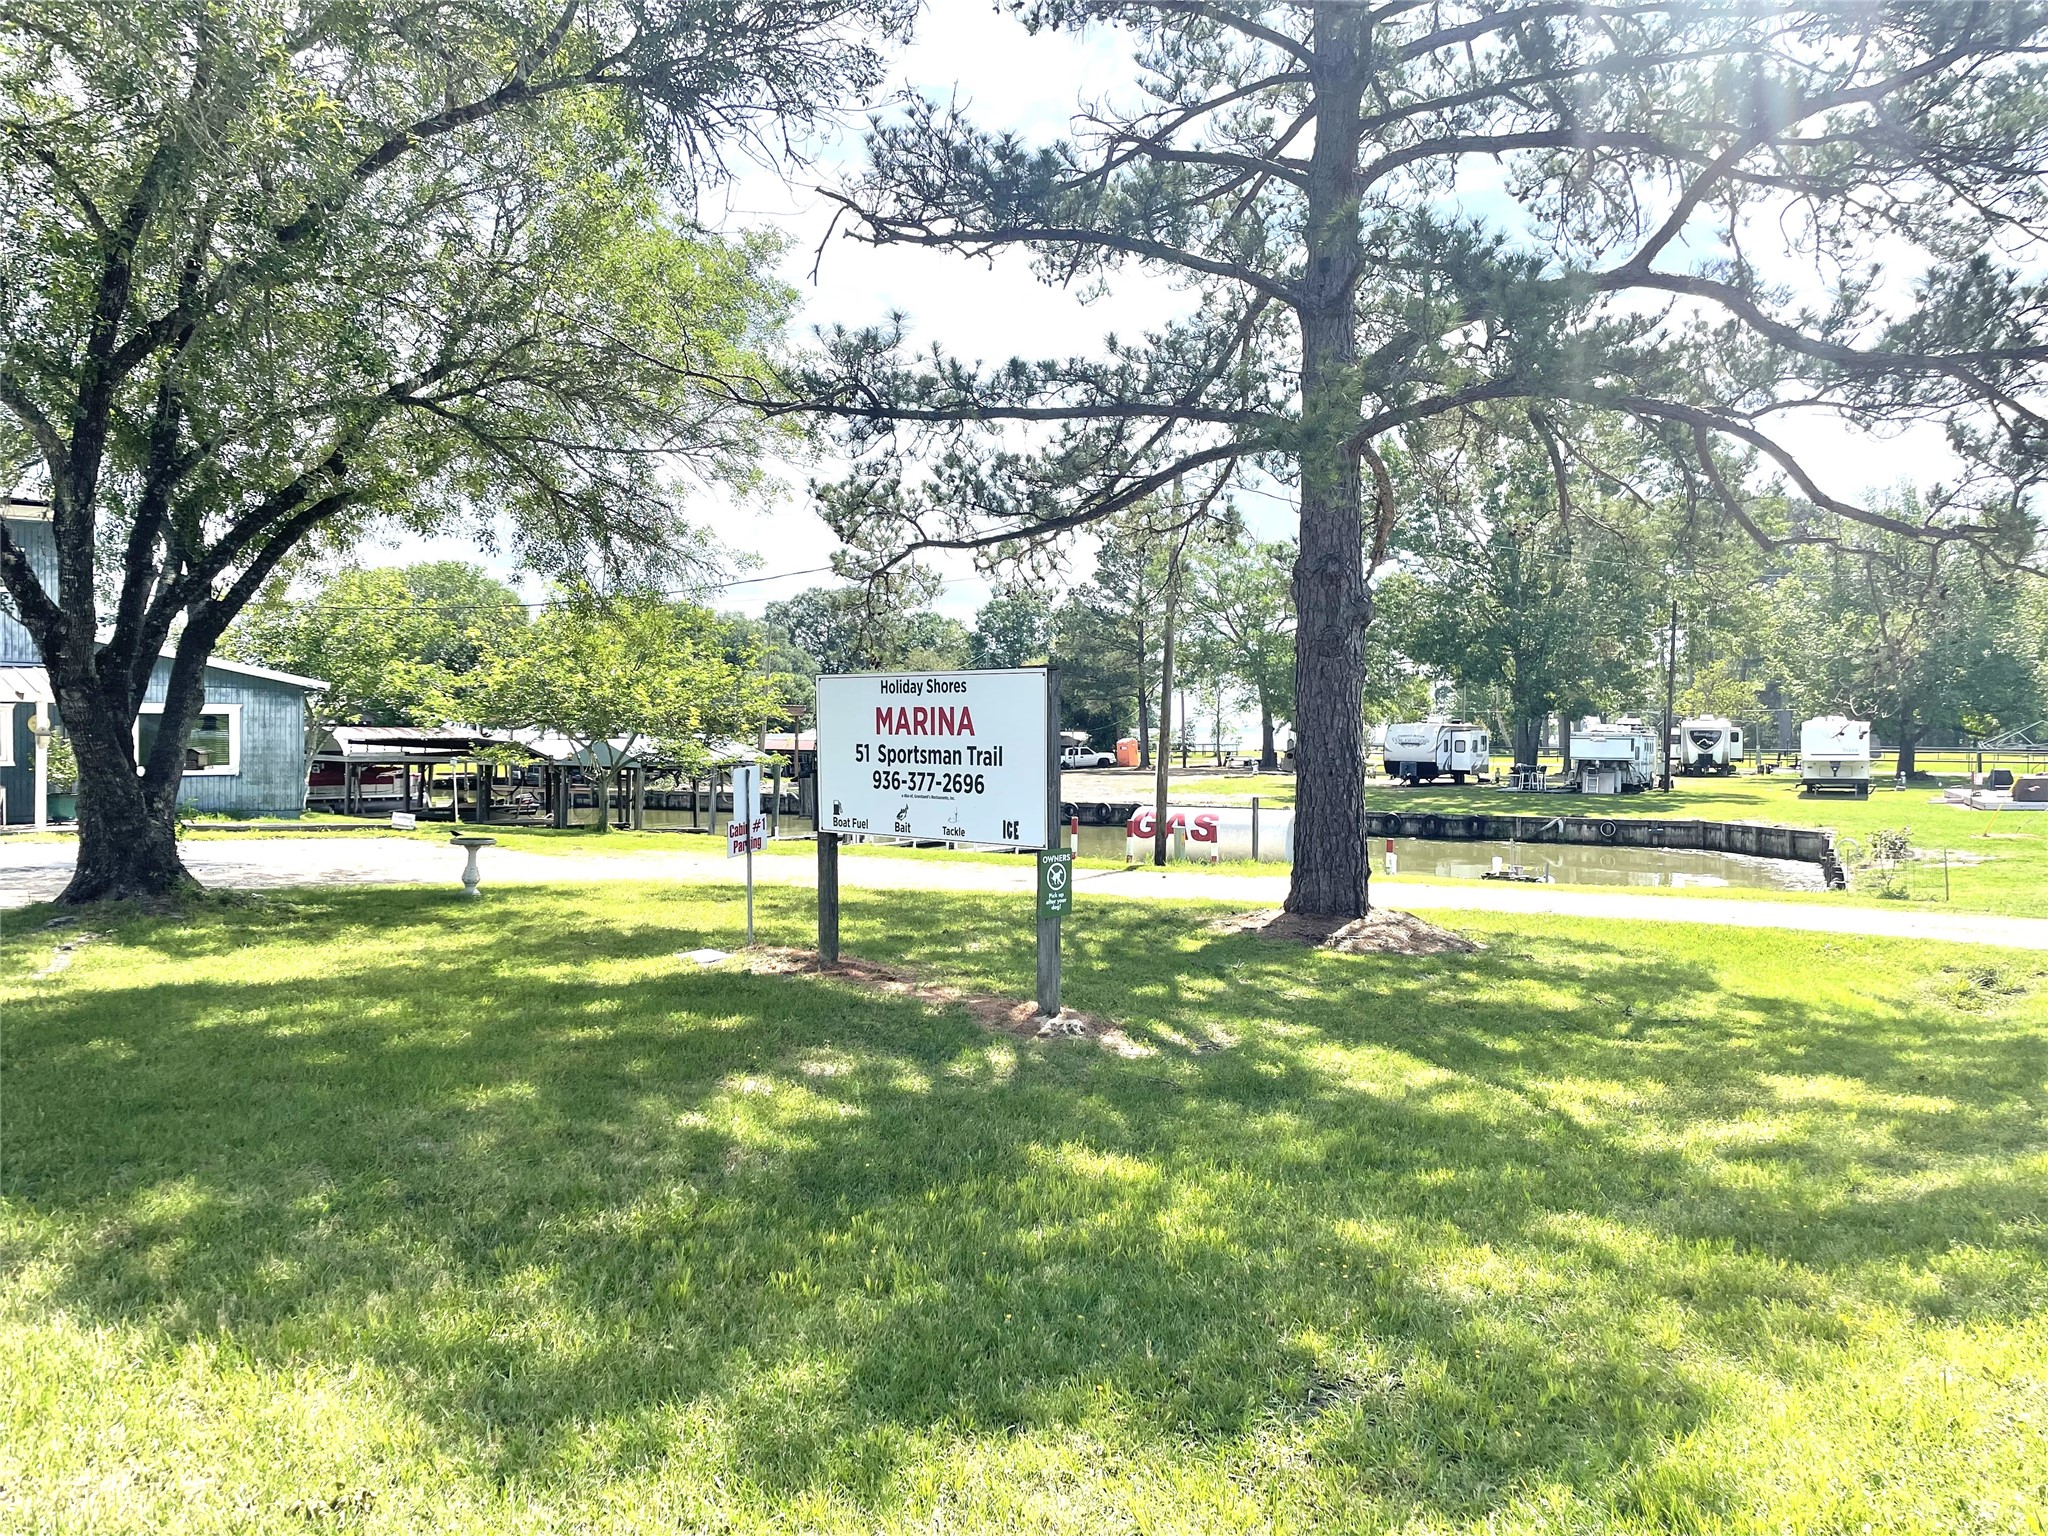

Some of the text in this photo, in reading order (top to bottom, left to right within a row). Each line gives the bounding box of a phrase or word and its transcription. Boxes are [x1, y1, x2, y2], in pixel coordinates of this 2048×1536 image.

[880, 678, 967, 696] Holiday Shores
[875, 706, 975, 736] MARINA
[855, 744, 1003, 767] 51 Sportsman Trail
[872, 770, 985, 794] 936-377-2696
[752, 817, 766, 833] #1
[833, 817, 869, 829] Boat Fuel
[894, 821, 911, 834] Bait
[942, 826, 966, 837] Tackle
[1003, 820, 1020, 840] ICE
[1133, 812, 1220, 842] GAS
[733, 836, 762, 854] Paring
[1042, 853, 1071, 864] OWNERS
